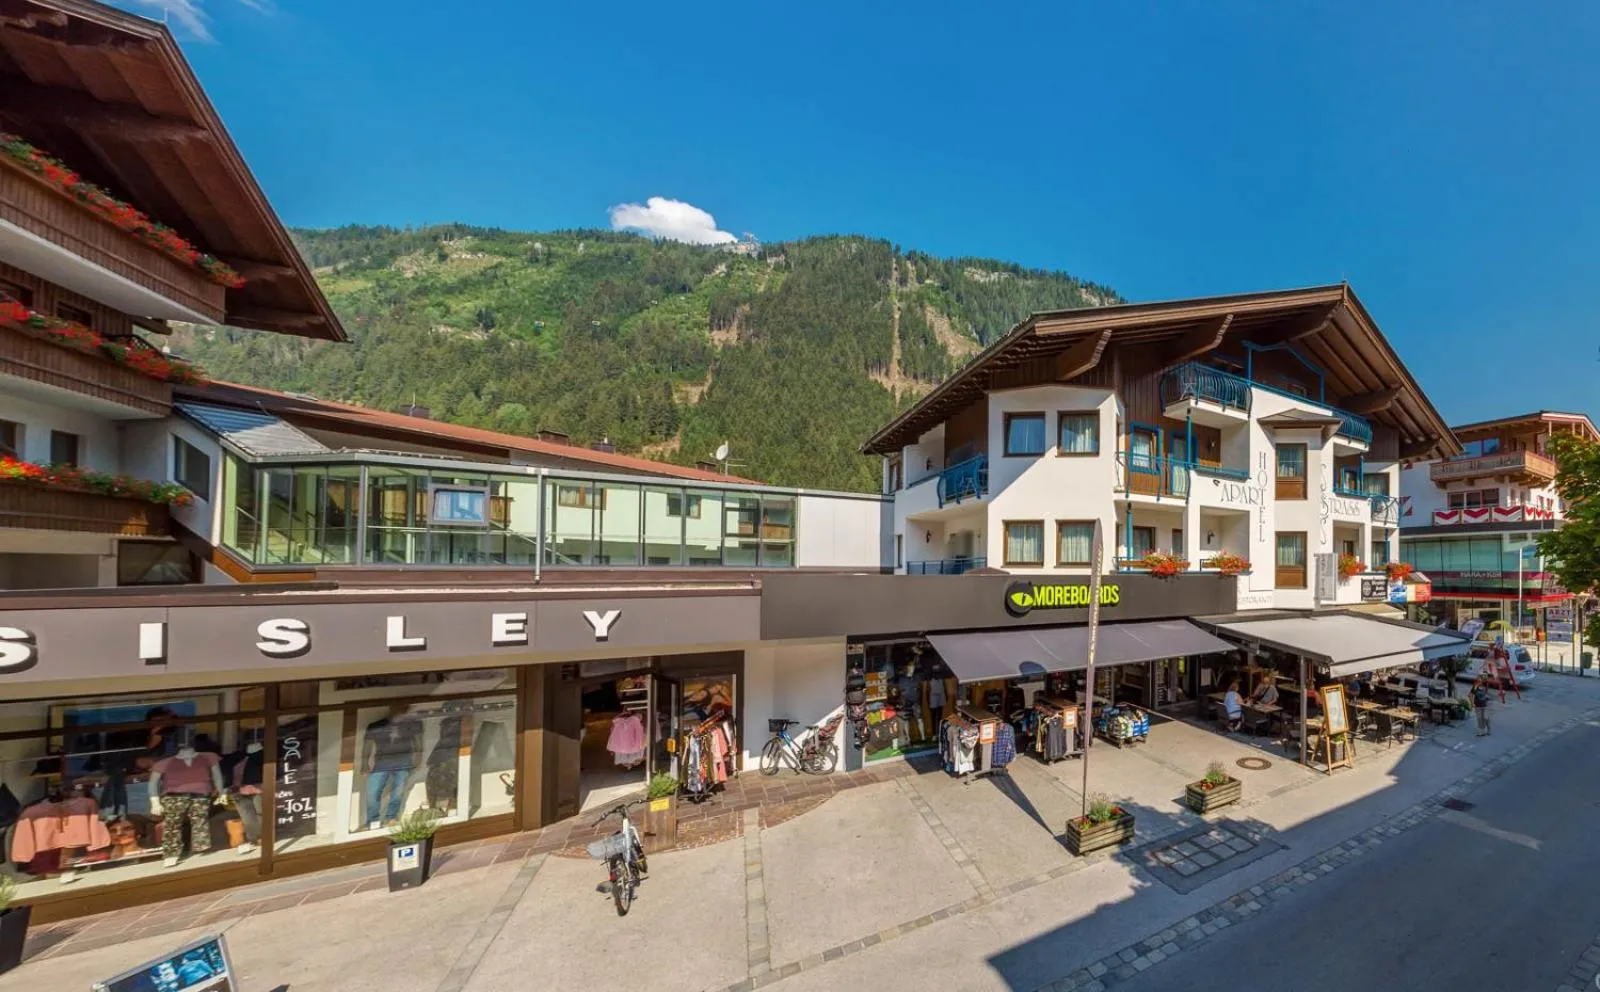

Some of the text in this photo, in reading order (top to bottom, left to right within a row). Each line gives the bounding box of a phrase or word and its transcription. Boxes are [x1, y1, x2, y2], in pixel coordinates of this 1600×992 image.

[1220, 483, 1266, 507] APART
[1257, 451, 1268, 543] HOTEL
[282, 736, 301, 785] SALE
